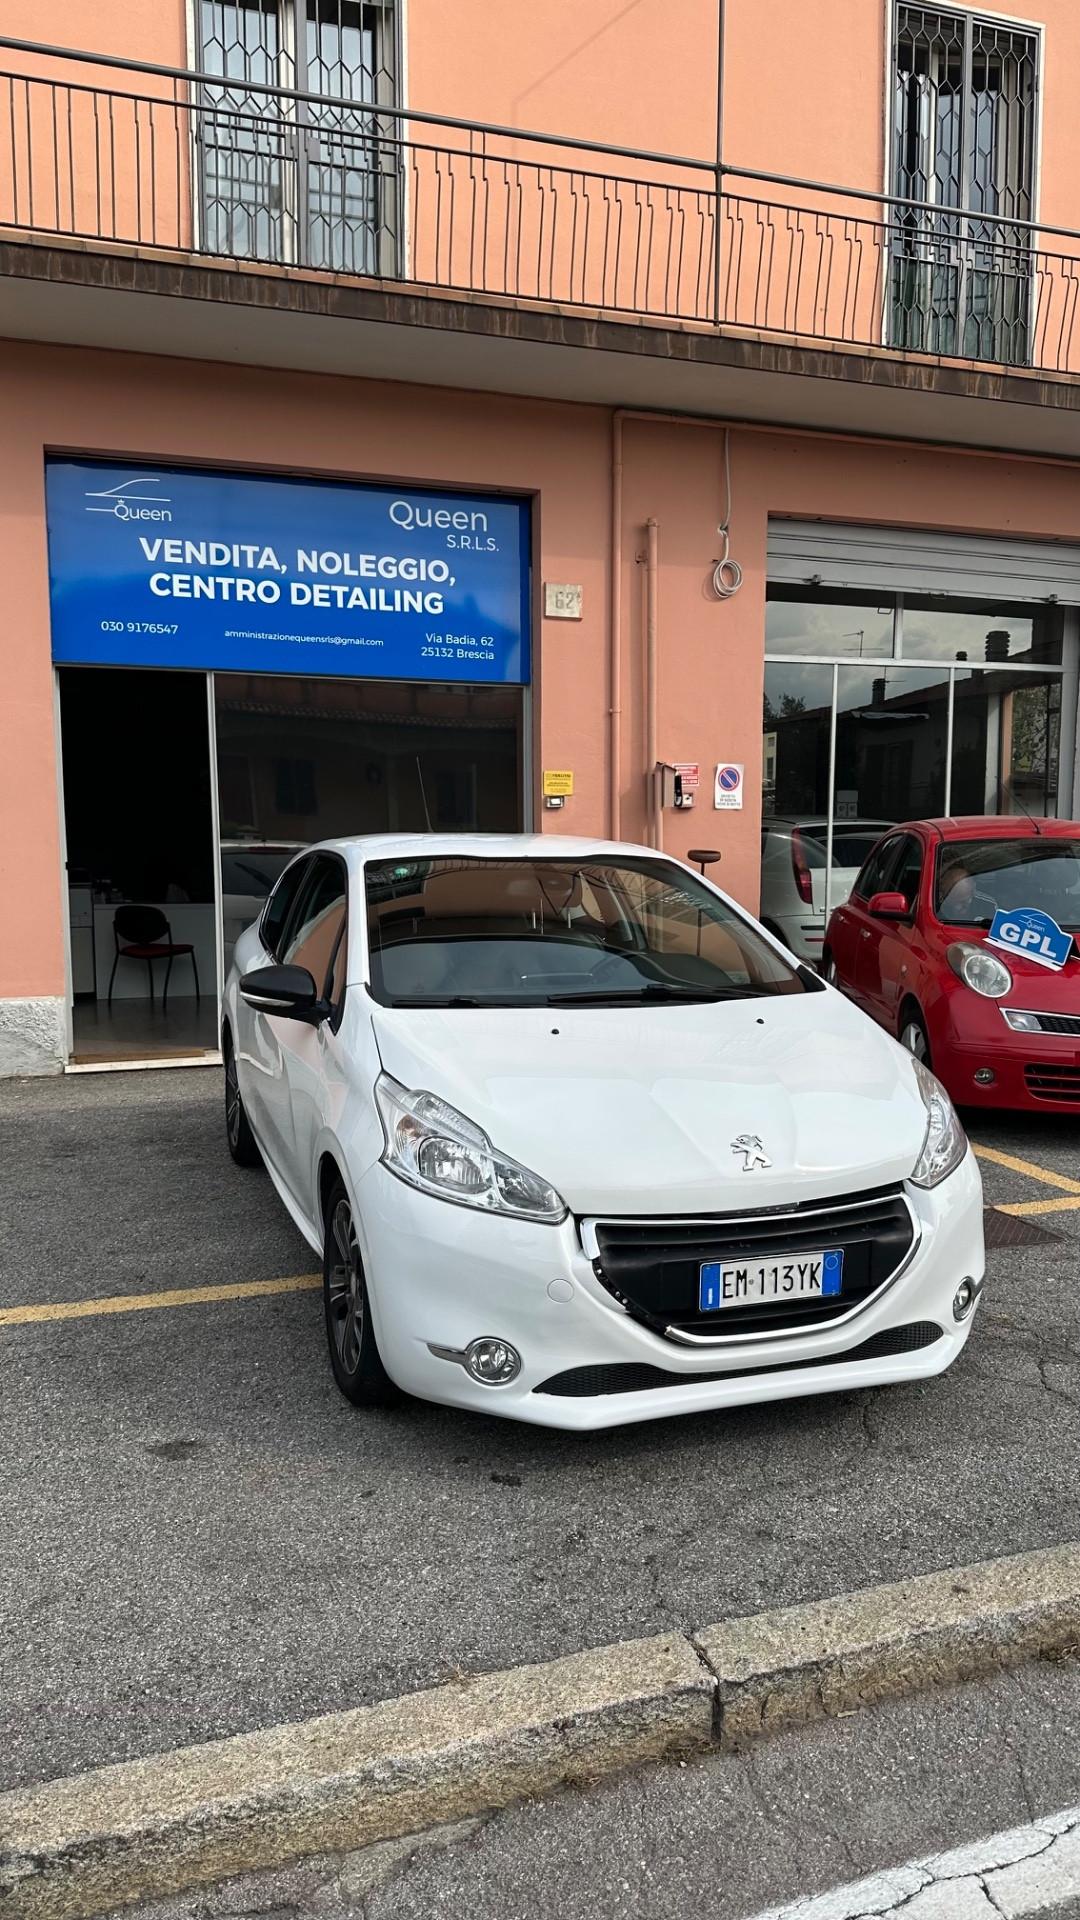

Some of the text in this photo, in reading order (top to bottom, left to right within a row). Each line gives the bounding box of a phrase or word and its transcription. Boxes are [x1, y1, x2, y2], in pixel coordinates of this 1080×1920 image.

[114, 502, 173, 522] Queen
[389, 500, 488, 532] Queen
[446, 534, 500, 552] S.R.L.S.
[138, 537, 456, 587] VENDITA, NOLEGGIO,
[149, 572, 444, 615] CENTRO DETAILING
[100, 620, 179, 635] 030 9176547
[224, 629, 384, 648] amministrazionequeensrls@gmail.com
[425, 632, 494, 647] Via Badia, 62
[420, 646, 495, 660] 25132 Brescia
[999, 922, 1057, 958] GPL
